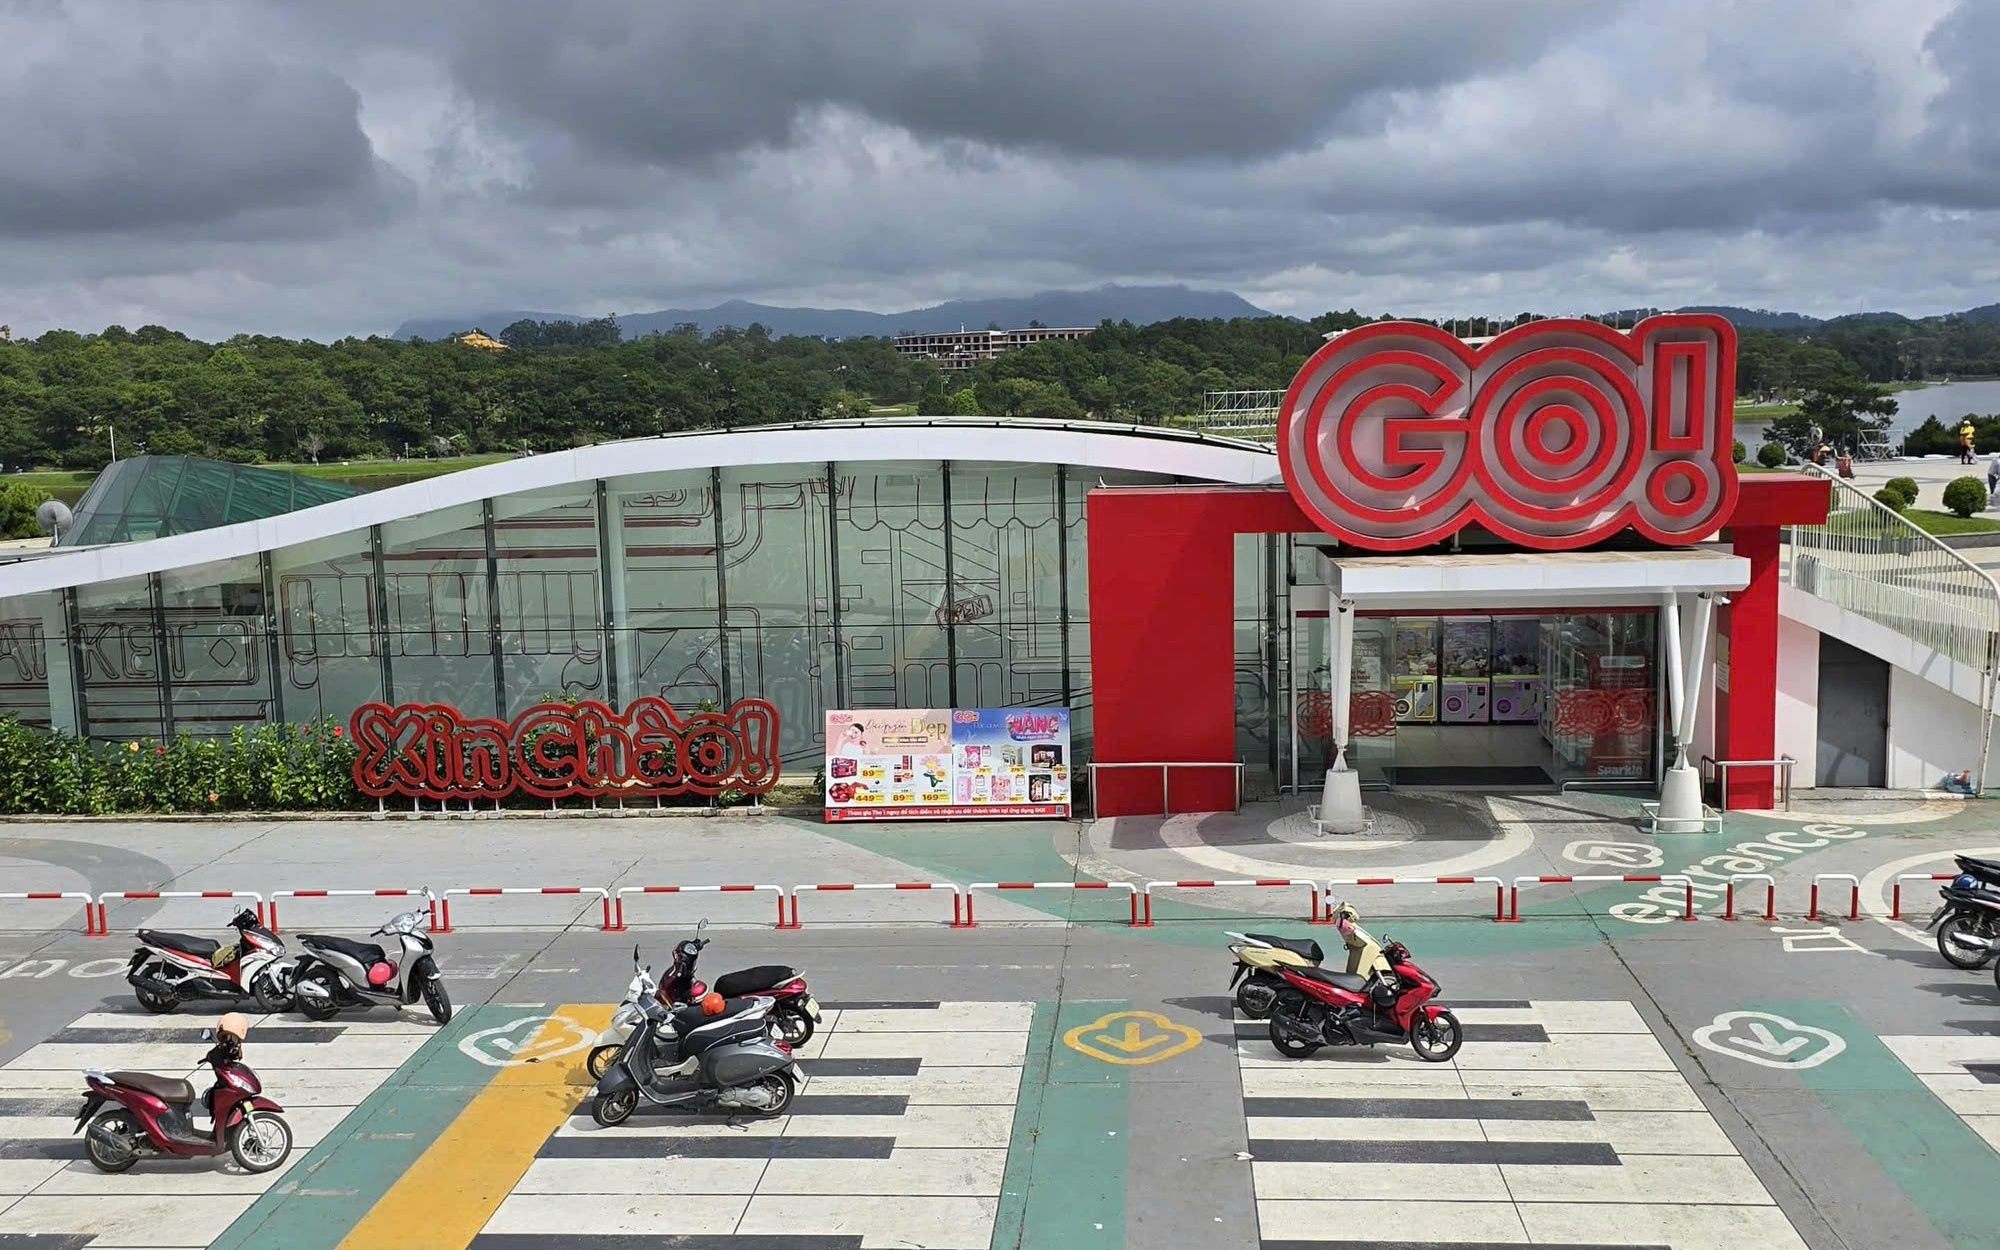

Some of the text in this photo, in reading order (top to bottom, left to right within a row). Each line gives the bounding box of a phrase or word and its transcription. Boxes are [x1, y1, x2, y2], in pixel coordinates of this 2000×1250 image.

[1281, 316, 1735, 547] GO!
[911, 717, 948, 740] Đẹp
[1608, 823, 1867, 924] entrance
